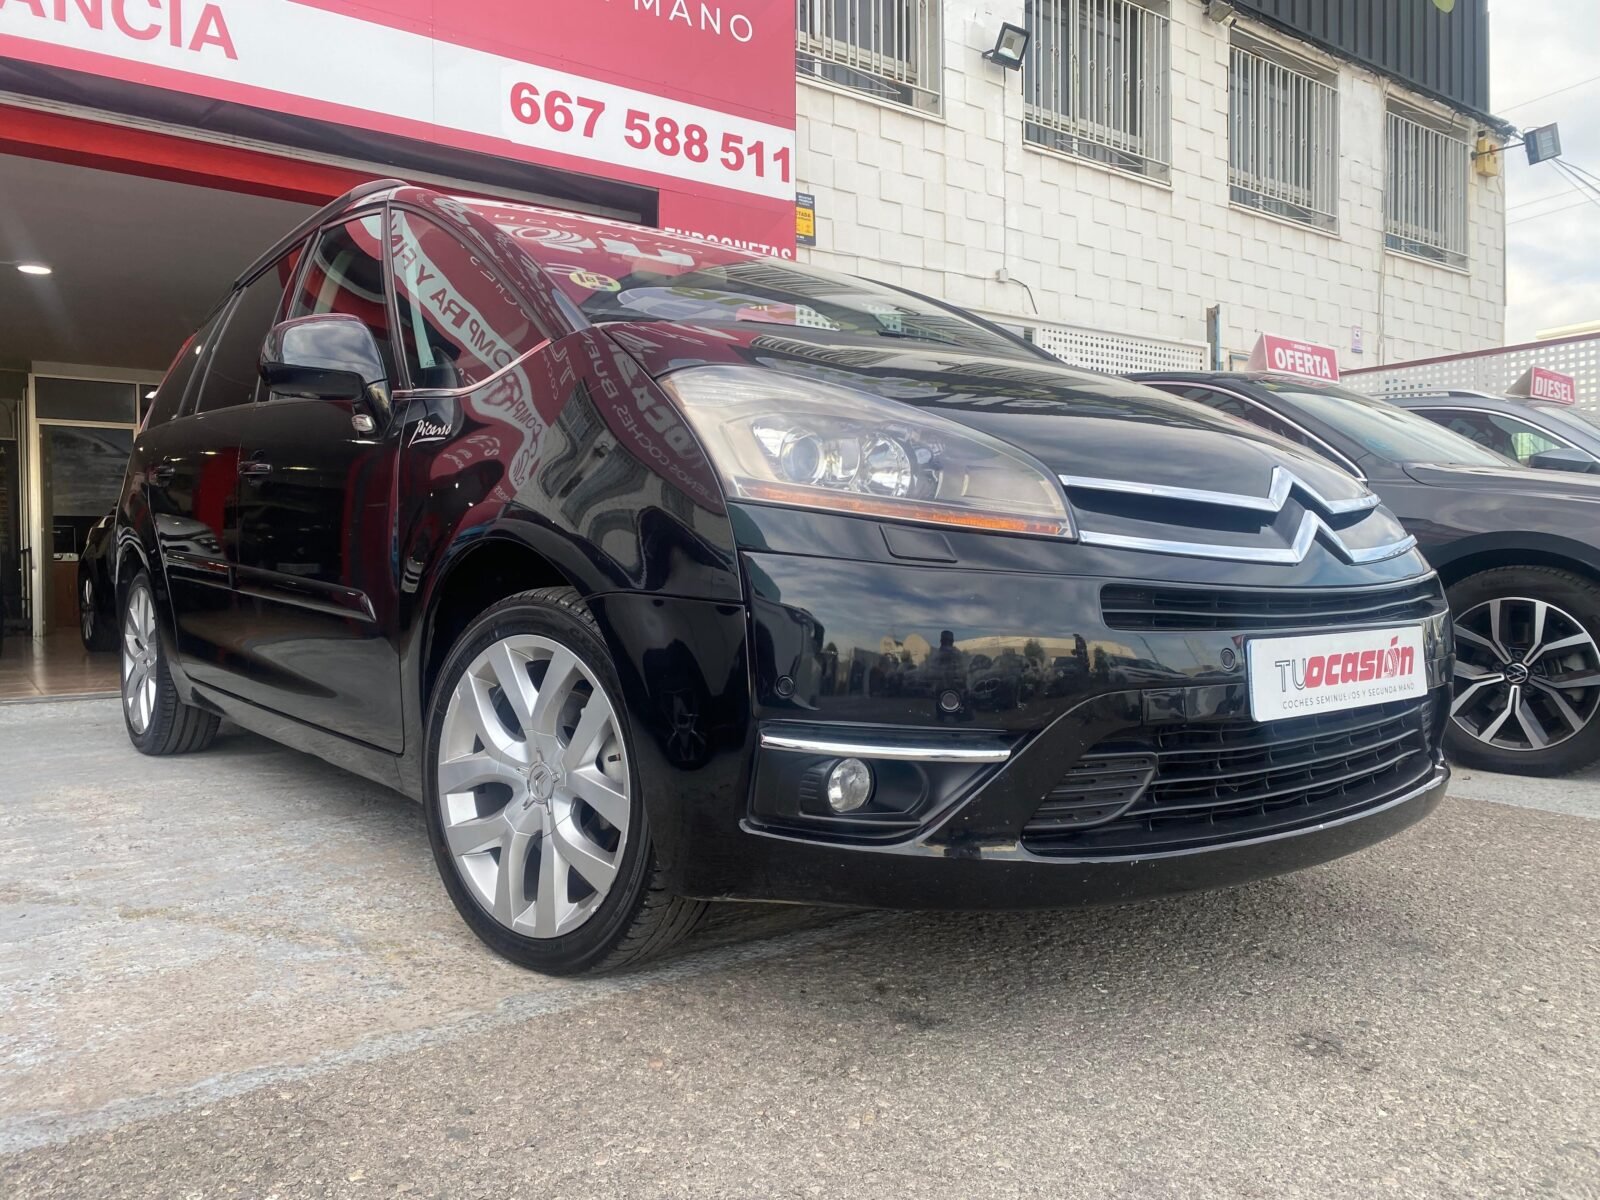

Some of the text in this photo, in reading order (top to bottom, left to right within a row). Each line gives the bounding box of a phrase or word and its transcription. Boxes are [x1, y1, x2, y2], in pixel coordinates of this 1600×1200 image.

[510, 81, 790, 183] 667 588 511
[1274, 346, 1332, 378] OFERTA
[1534, 376, 1574, 402] DIESEL
[1282, 697, 1314, 710] COCHES
[1315, 690, 1360, 705] SEMINUEOS
[1361, 688, 1367, 696] Y
[1368, 685, 1397, 697] SEGUNDA
